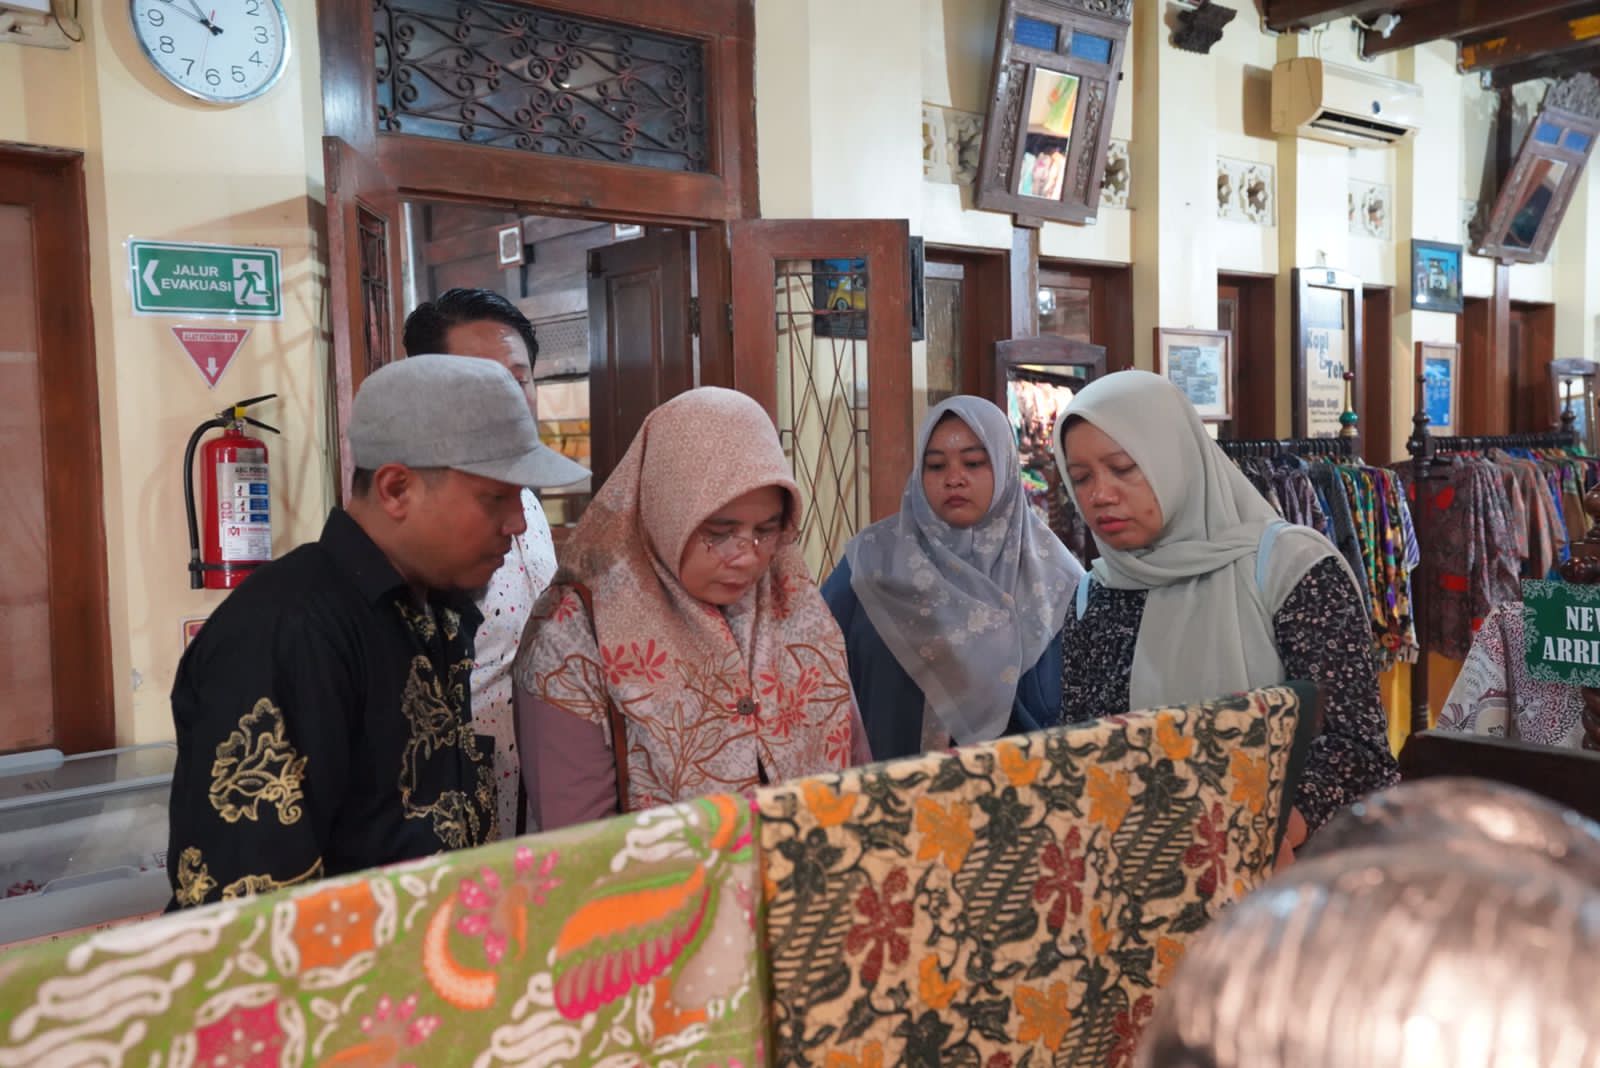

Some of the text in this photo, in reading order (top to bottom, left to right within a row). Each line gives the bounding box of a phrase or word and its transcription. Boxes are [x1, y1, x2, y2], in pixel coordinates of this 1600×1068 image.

[147, 8, 164, 27] 9
[245, 0, 260, 17] 2
[254, 26, 269, 44] 3
[159, 35, 175, 54] 8
[180, 58, 195, 76] 7
[248, 50, 263, 67] 4
[205, 68, 221, 86] 6
[231, 65, 246, 83] 5
[172, 264, 220, 278] JALUR
[161, 278, 232, 292] EVAKUASI
